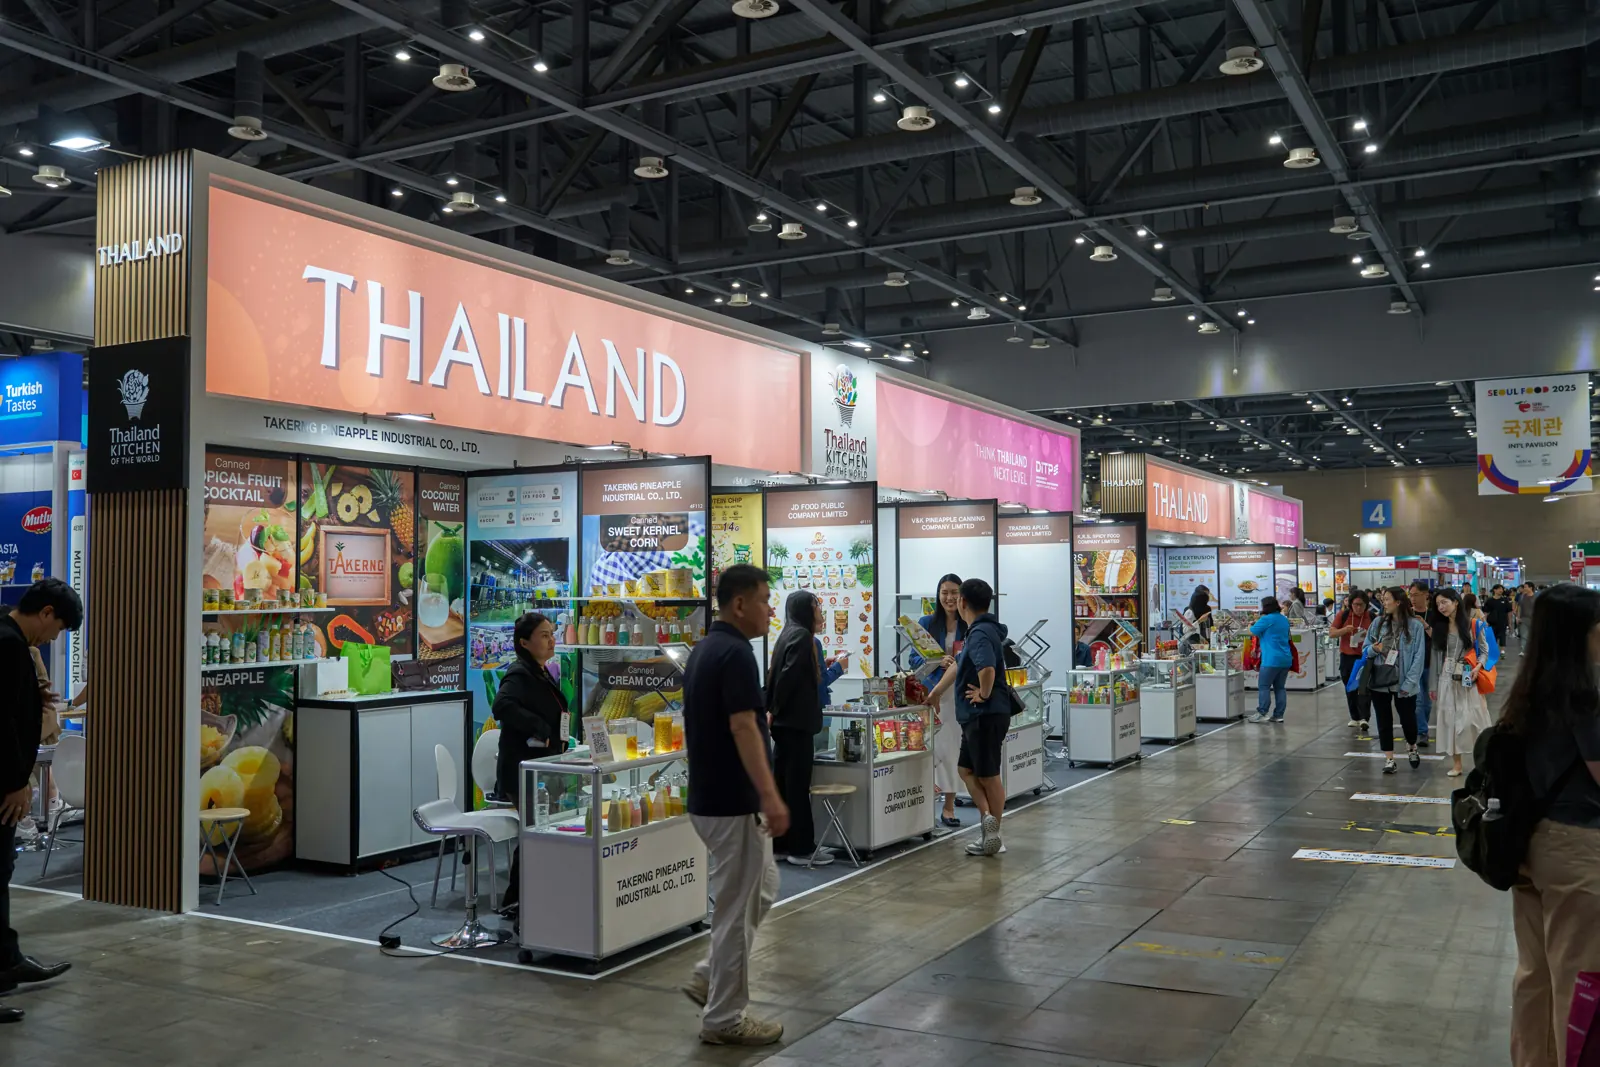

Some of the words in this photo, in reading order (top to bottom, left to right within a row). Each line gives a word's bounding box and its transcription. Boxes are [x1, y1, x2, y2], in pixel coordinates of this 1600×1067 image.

[97, 233, 184, 267] THAILAND
[302, 265, 687, 428] THAILAND
[6, 380, 43, 398] Turkish
[1487, 388, 1518, 397] SEOUL
[1521, 385, 1549, 395] FOOD
[1552, 384, 1576, 393] 2025
[7, 397, 37, 413] Tastes
[109, 424, 160, 443] Thailand
[263, 415, 317, 434] TAKERNG
[381, 430, 437, 448] INDUSTRIAL
[440, 439, 459, 452] CO.,
[461, 441, 481, 455] LTD.
[1502, 416, 1563, 438] 국제관
[824, 428, 867, 453] Thailand
[110, 442, 161, 456] KITCHEN
[975, 443, 996, 460] THINK
[997, 449, 1028, 468] THAILAND
[110, 456, 119, 465] OF
[121, 455, 134, 465] THE
[136, 454, 160, 463] WORLD
[215, 457, 251, 470] Canned
[826, 449, 868, 469] KITCHEN
[826, 465, 834, 474] OF
[836, 466, 847, 476] THE
[993, 466, 1009, 482] NEXT
[1011, 470, 1027, 486] LEVEL
[204, 470, 246, 486] PICAL
[247, 473, 283, 489] FRUIT
[439, 481, 460, 491] Canned
[603, 482, 638, 492] TAKERNG
[639, 480, 682, 491] PINEAPPLE
[1102, 478, 1143, 488] THAILAND
[204, 486, 265, 503] COCKTAIL
[421, 489, 460, 503] COCONUT
[602, 492, 646, 503] INDUSTRIAL
[647, 492, 664, 501] CO.,
[665, 491, 683, 500] LTD.
[1153, 481, 1209, 524] THAILAND
[432, 500, 460, 513] WATER
[788, 511, 820, 519] COMPANY
[821, 510, 848, 518] LIMITED
[790, 503, 799, 511] JD
[1369, 503, 1385, 525] 4
[23, 510, 52, 527] Mutlu
[631, 515, 658, 525] Canned
[608, 526, 640, 537] SWEET
[642, 525, 682, 536] KERNEL
[630, 538, 658, 548] CORN
[328, 551, 384, 573] TAKERNG
[73, 550, 81, 591] MUTLU
[72, 628, 80, 684] RNACILIK
[437, 664, 460, 672] Canned
[627, 665, 655, 675] Canned
[203, 671, 265, 686] INEAPPLE
[430, 673, 460, 684] CONUT
[607, 675, 643, 687] CREAM
[645, 675, 674, 687] CORN
[886, 793, 893, 803] JD
[893, 789, 906, 800] FOOD
[907, 785, 923, 797] PUBLIC
[884, 801, 907, 815] COMPANY
[907, 795, 925, 808] LIMITED
[617, 871, 653, 891] TAKERNG
[655, 857, 695, 884] PINEAPPLE
[616, 884, 660, 907] INDUSTRIAL
[662, 875, 679, 891] CO.,
[680, 872, 696, 888] LTD.
